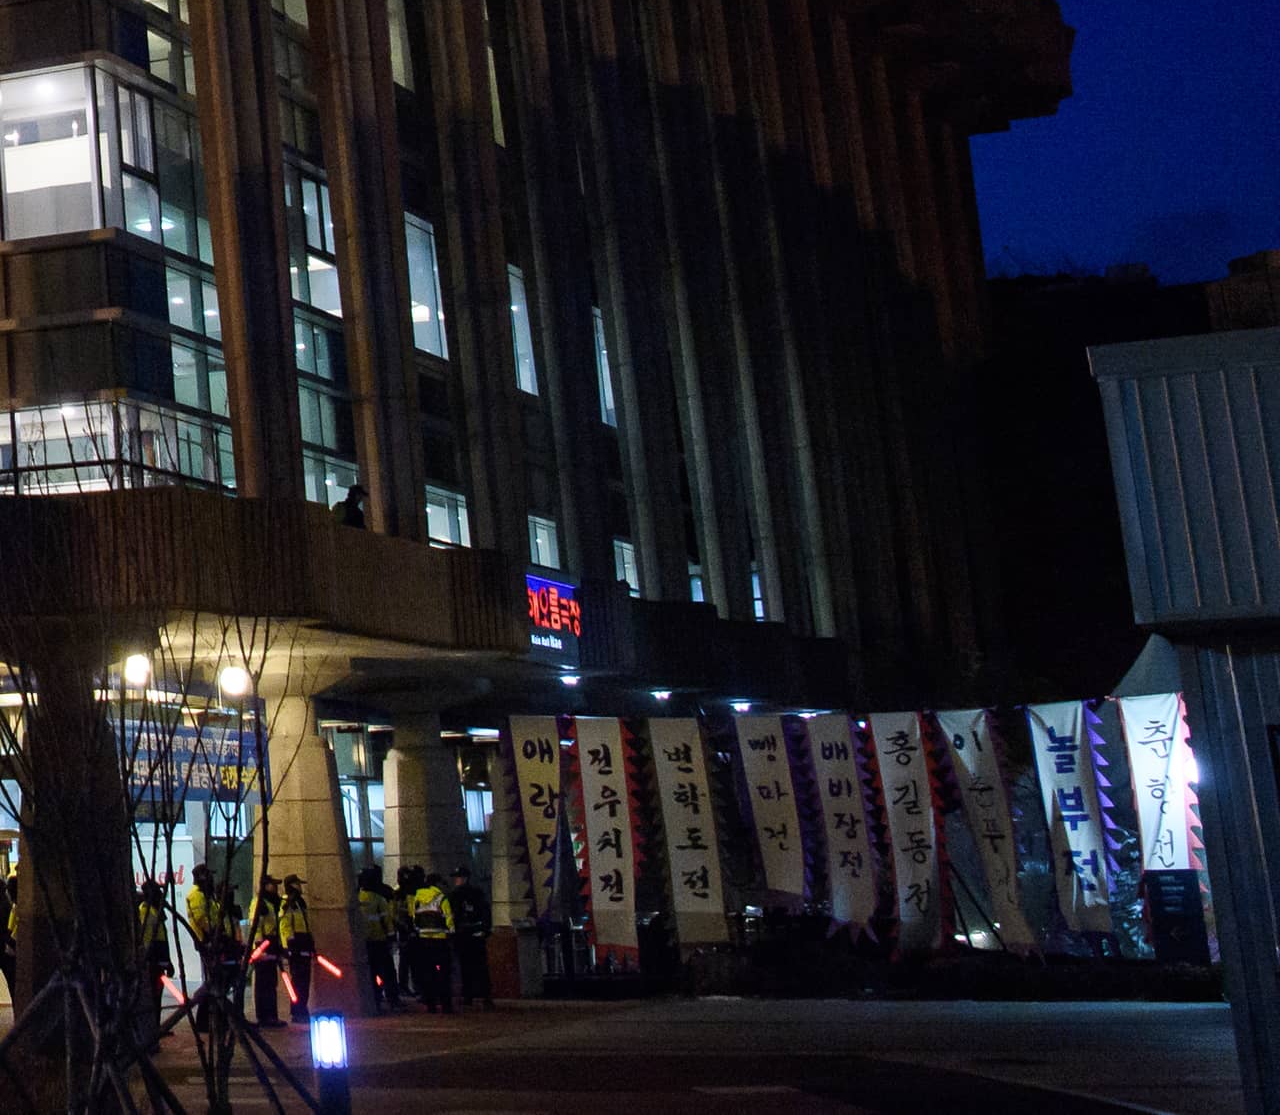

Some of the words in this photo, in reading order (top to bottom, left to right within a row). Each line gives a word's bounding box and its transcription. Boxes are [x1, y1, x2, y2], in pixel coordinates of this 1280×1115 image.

[586, 743, 625, 903] 전우치전
[820, 740, 863, 878] 배비장전
[883, 730, 933, 914] 홍길동전
[1045, 725, 1100, 892] 놀부전
